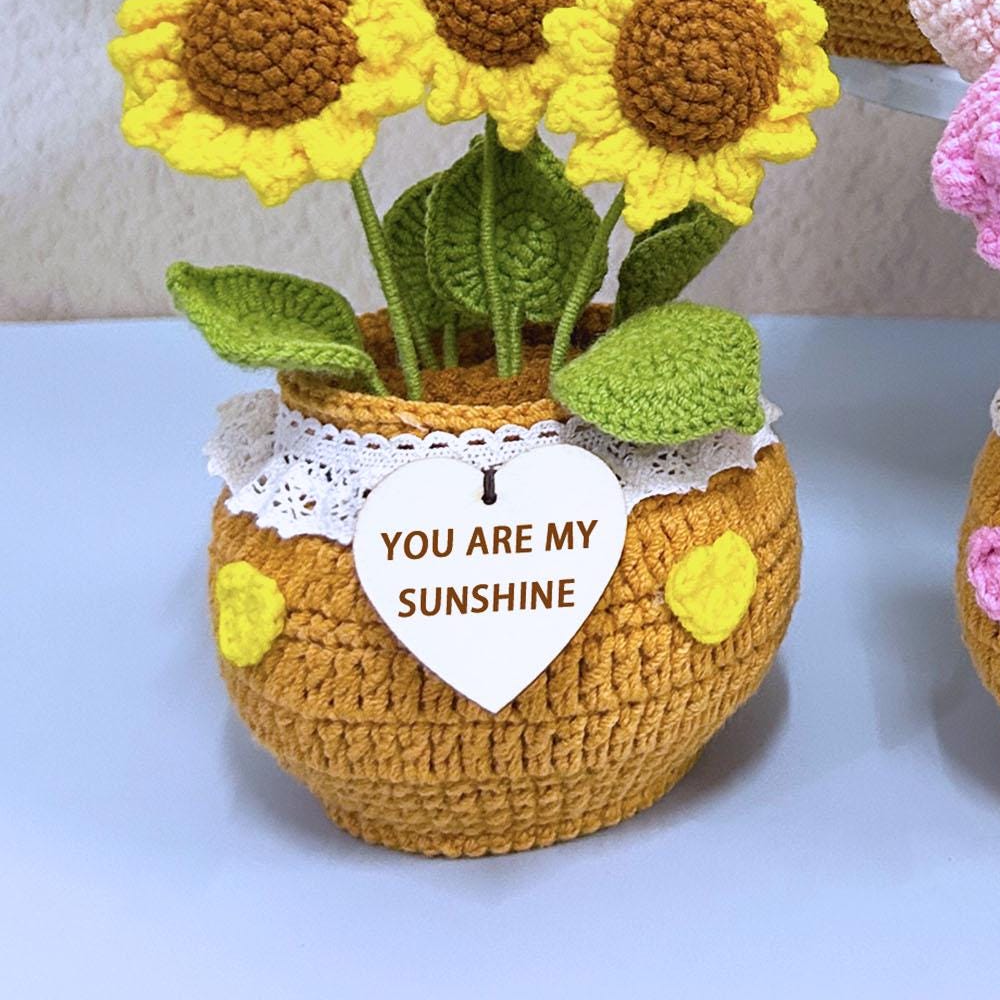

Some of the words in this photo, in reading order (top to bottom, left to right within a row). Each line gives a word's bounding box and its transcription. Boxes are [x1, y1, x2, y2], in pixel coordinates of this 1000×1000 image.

[380, 528, 454, 561] YOU
[466, 524, 533, 556] ARE
[545, 519, 599, 552] MY
[398, 578, 575, 618] SUNSHINE
